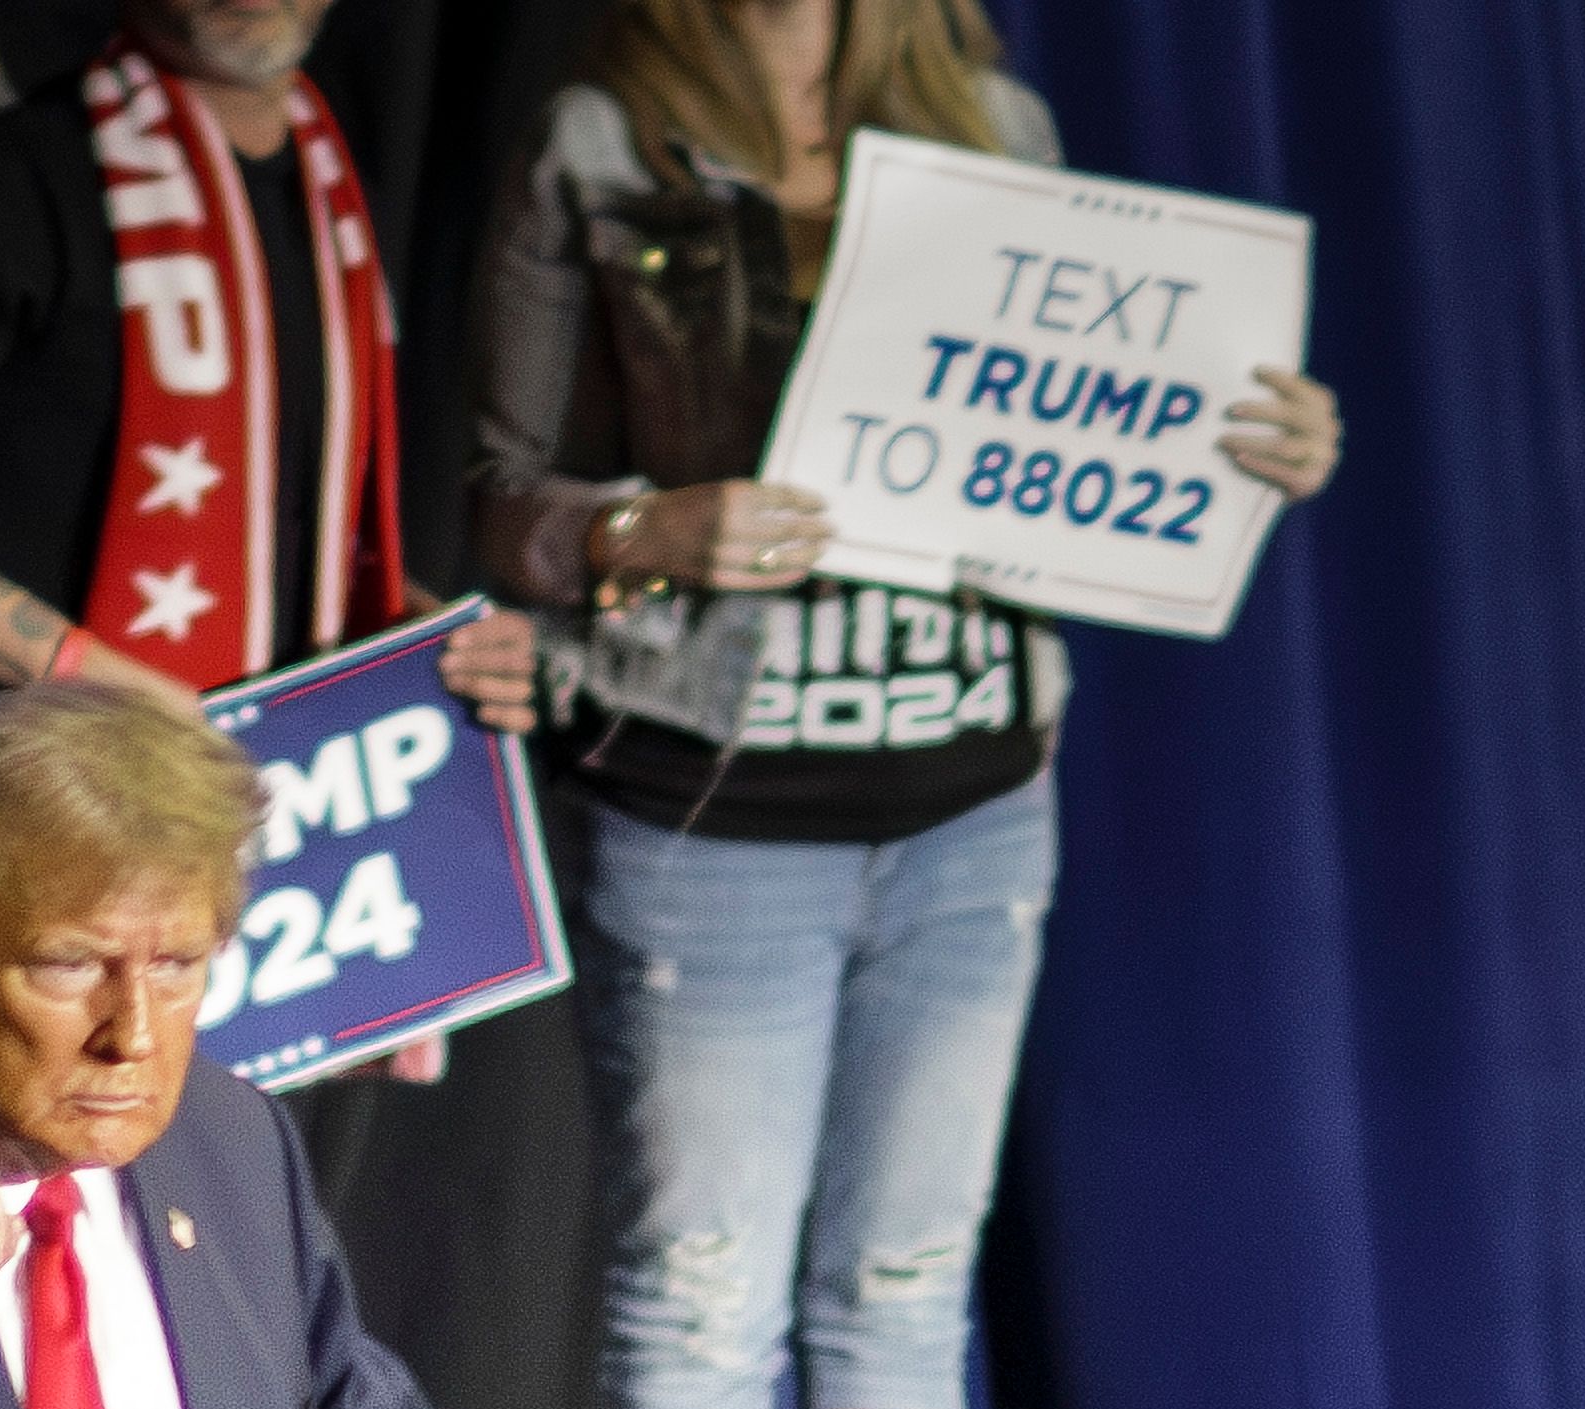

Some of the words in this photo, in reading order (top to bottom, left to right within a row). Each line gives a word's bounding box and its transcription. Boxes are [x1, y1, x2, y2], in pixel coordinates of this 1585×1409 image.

[996, 246, 1200, 350] TEXT
[923, 334, 1205, 441] TRUMP
[843, 412, 941, 496] TO
[961, 440, 1215, 546] 88022
